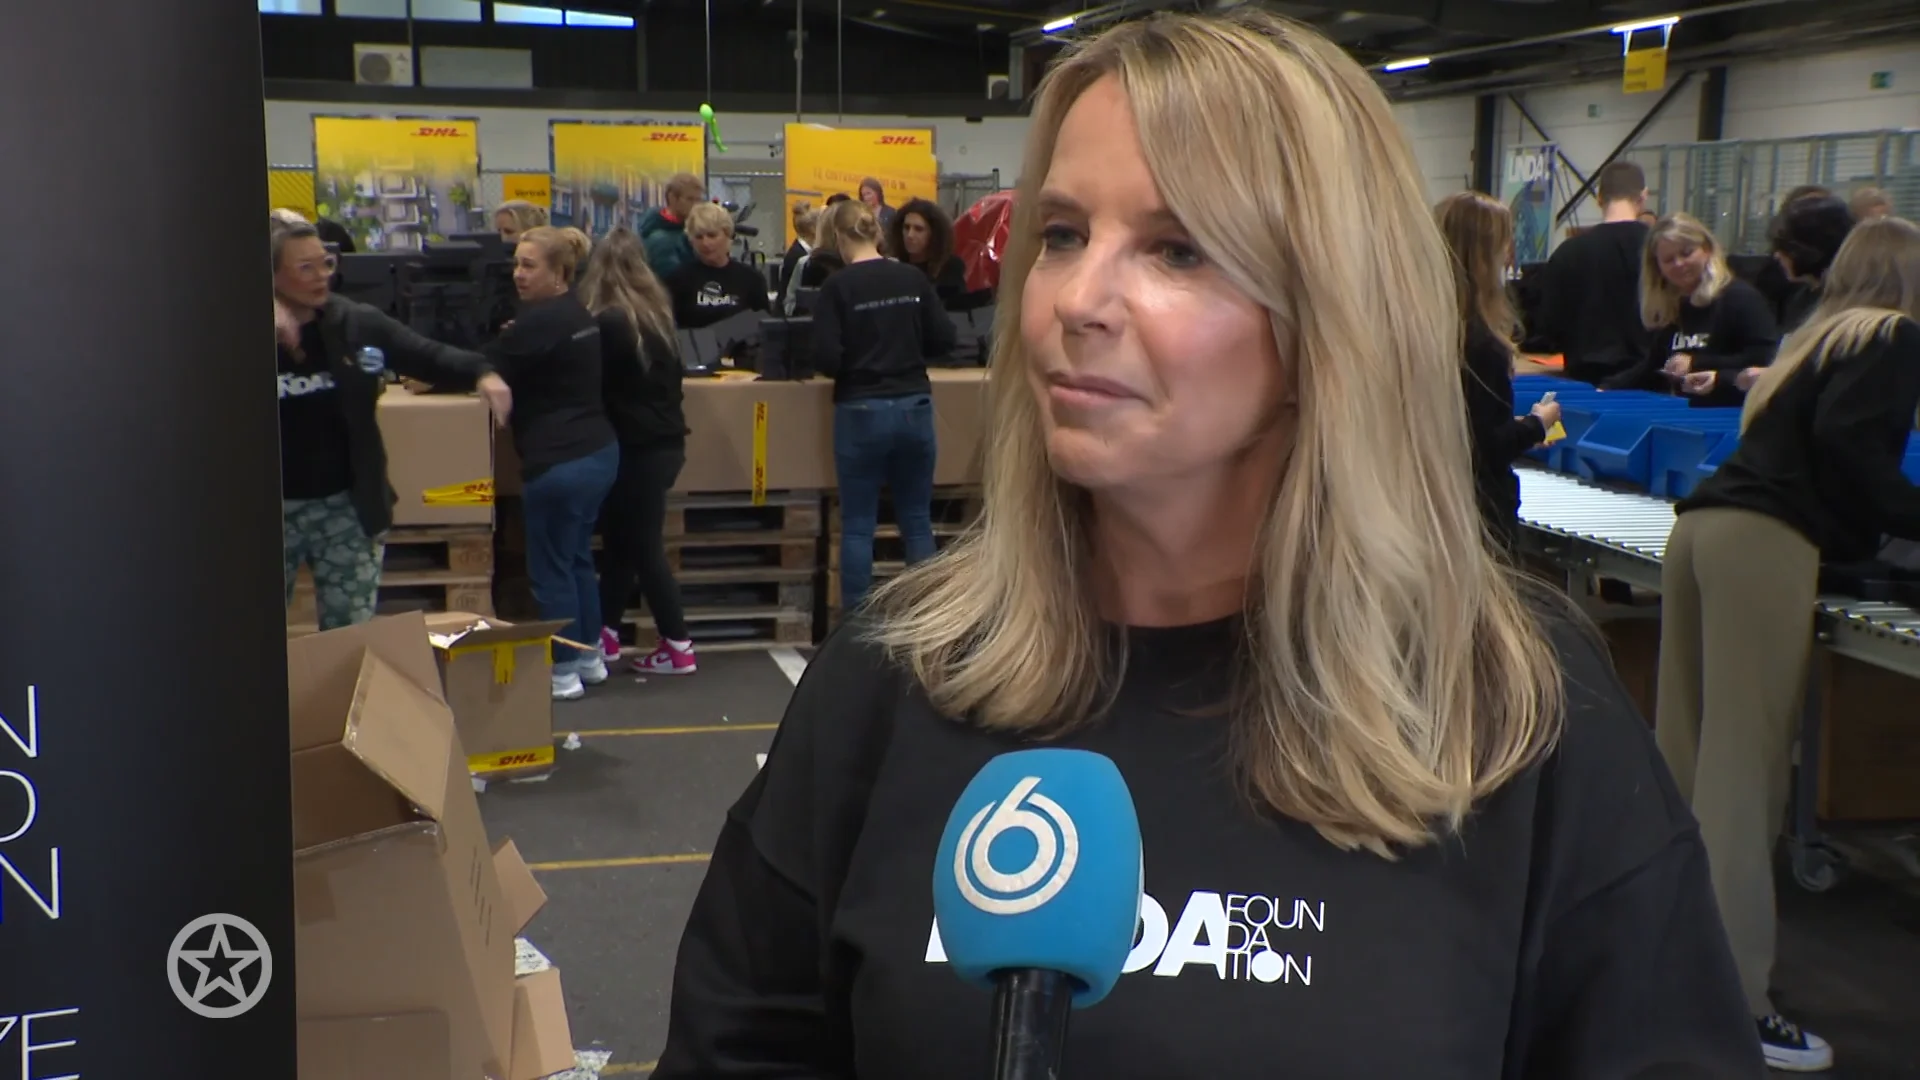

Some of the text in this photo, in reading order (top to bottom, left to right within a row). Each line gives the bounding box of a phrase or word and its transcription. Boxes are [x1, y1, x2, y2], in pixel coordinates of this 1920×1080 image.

[418, 126, 461, 137] DHL
[649, 131, 690, 142] DHL
[880, 135, 918, 145] DHL
[497, 752, 540, 766] DHL
[960, 776, 1072, 907] 6
